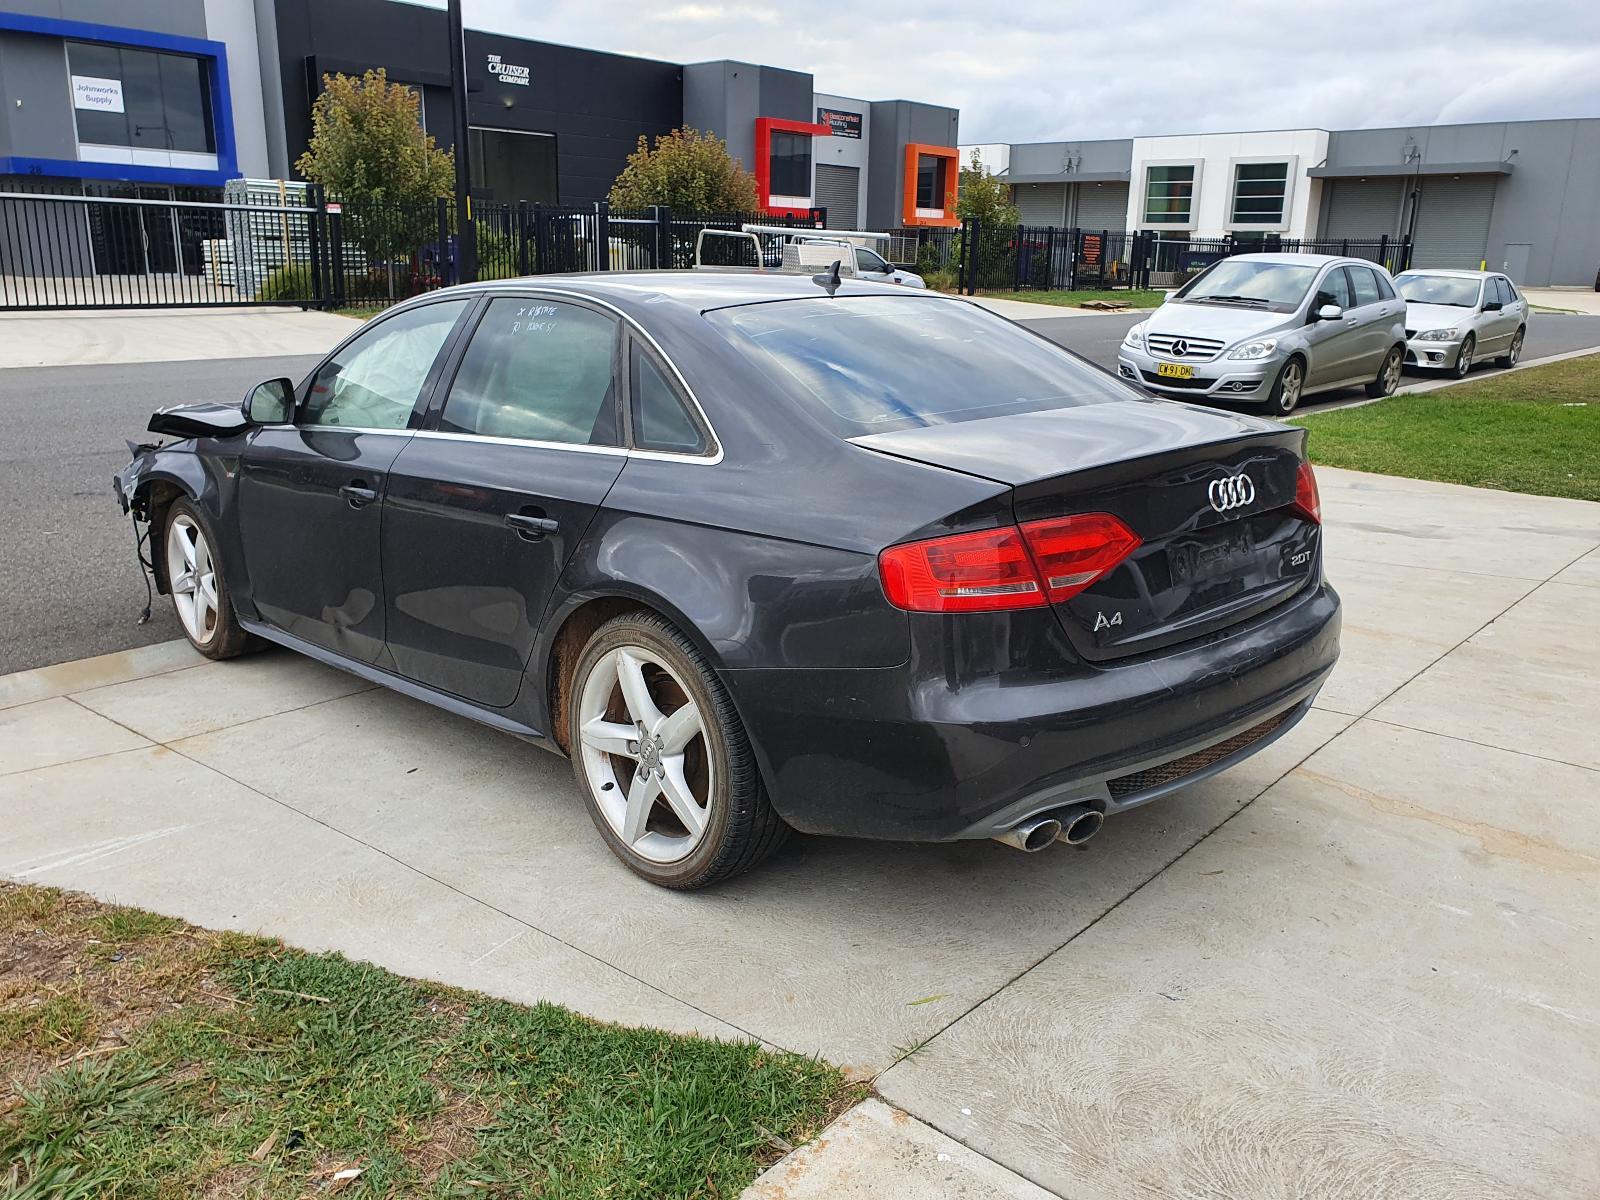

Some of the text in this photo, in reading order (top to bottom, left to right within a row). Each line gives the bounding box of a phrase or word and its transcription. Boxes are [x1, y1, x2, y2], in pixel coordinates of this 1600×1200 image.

[487, 62, 530, 78] CRUISER
[498, 74, 530, 86] COMPANY
[76, 84, 119, 95] Johnworks
[85, 94, 113, 105] Supply
[1093, 611, 1123, 632] A4
